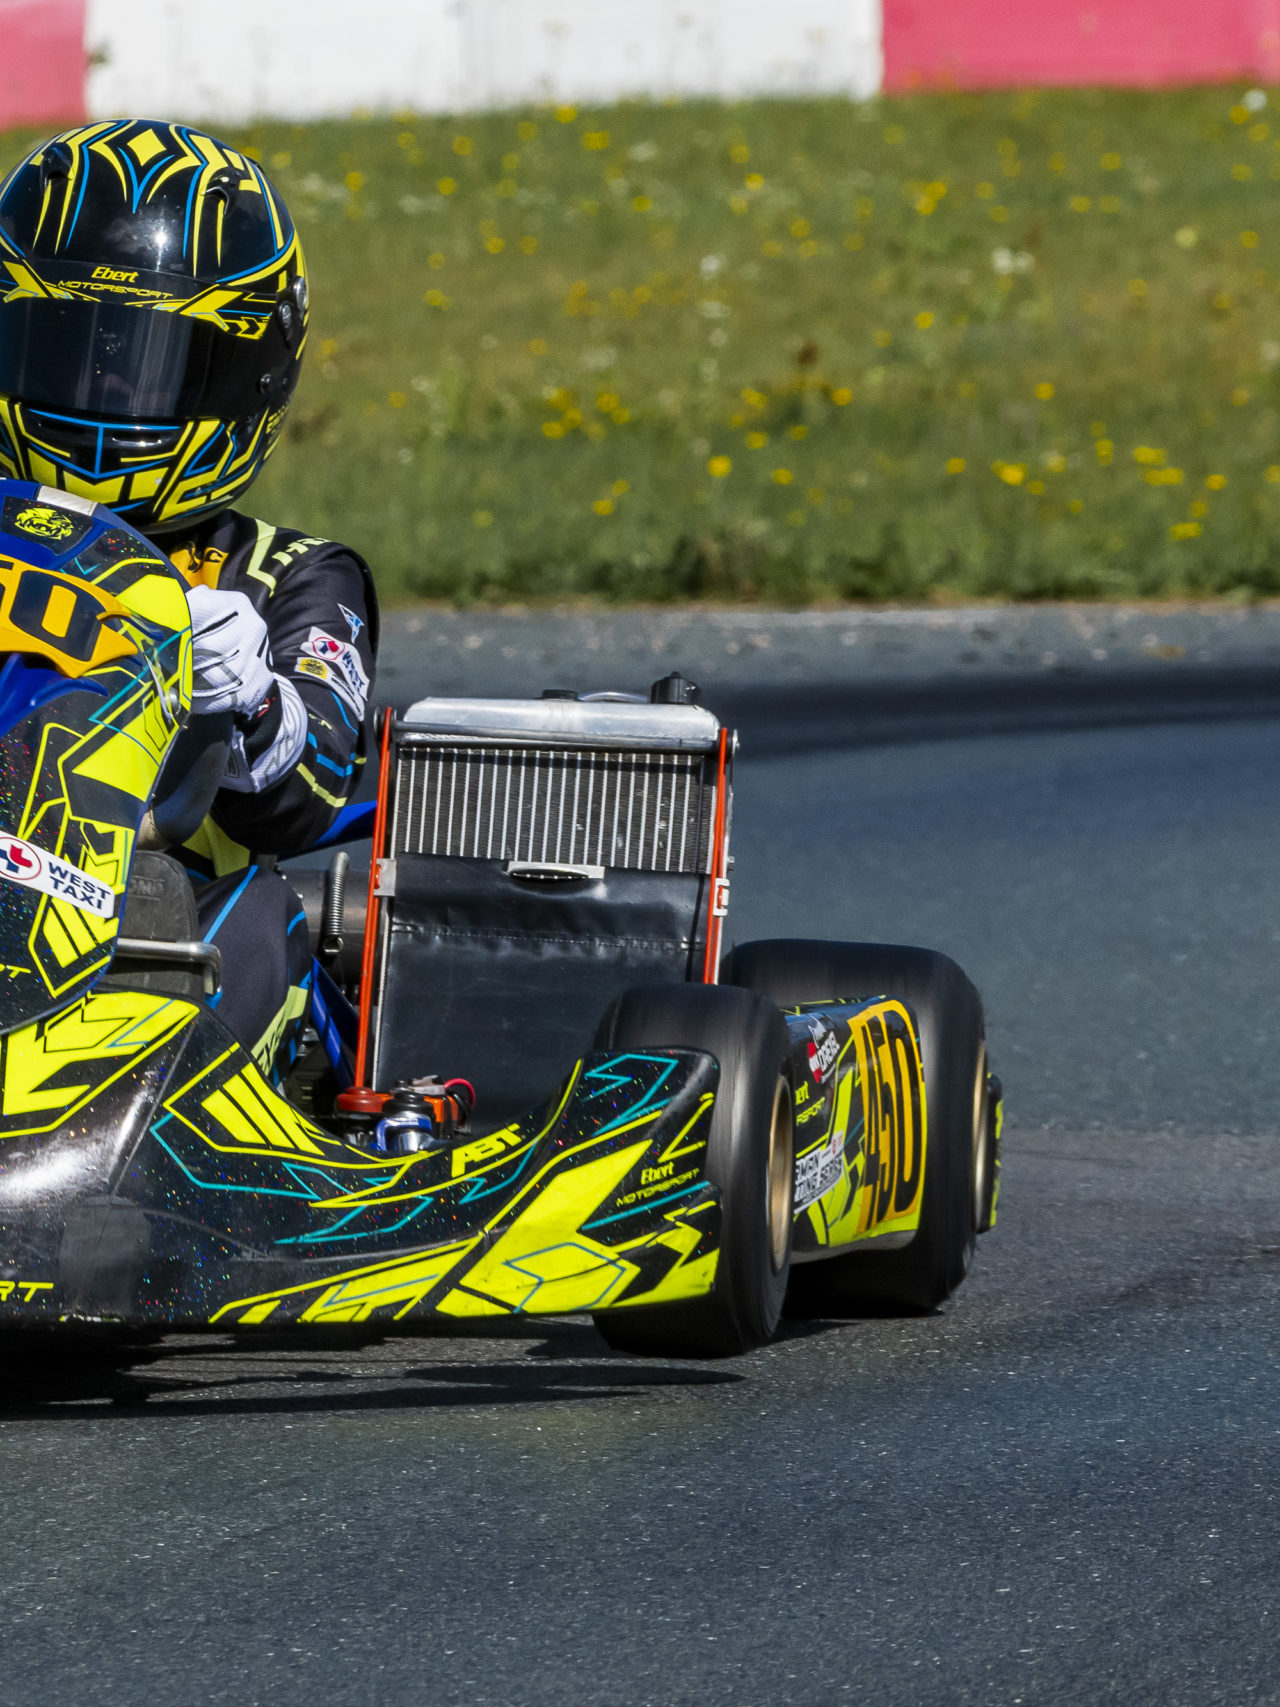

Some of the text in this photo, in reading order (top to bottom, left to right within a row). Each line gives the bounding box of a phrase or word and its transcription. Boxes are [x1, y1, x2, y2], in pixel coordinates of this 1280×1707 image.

[58, 280, 174, 299] MOTORSPORT
[91, 266, 139, 283] Ebert
[48, 860, 111, 899] WEST
[48, 876, 103, 911] TAXI
[861, 1009, 922, 1230] 450
